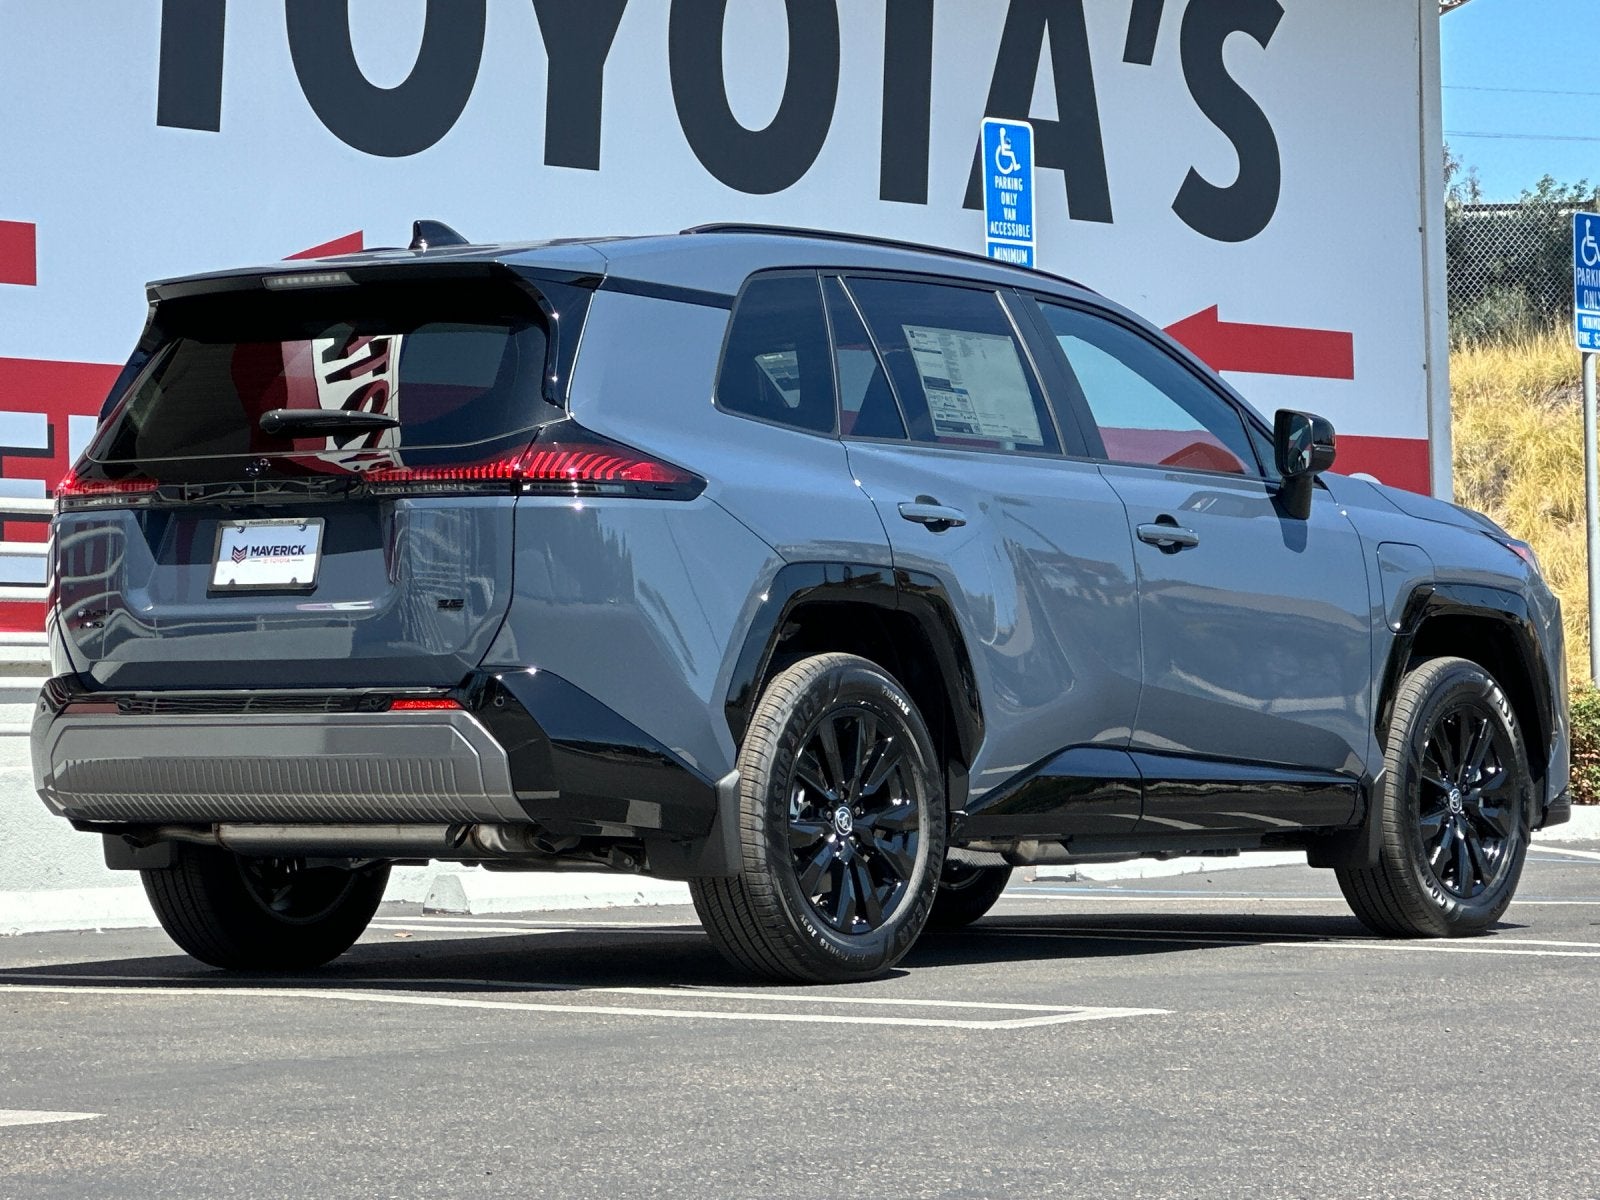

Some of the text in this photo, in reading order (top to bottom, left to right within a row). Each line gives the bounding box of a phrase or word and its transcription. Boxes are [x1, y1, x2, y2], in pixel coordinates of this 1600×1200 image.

[994, 175, 1024, 191] PARKING
[1000, 191, 1018, 206] ONLY
[1004, 207, 1016, 221] VAN
[990, 221, 1030, 238] ACCESSIBLE
[994, 246, 1028, 263] MINIMUM
[1577, 267, 1600, 288] PARKI
[1579, 331, 1591, 345] FINE
[250, 544, 307, 557] MAVERICK
